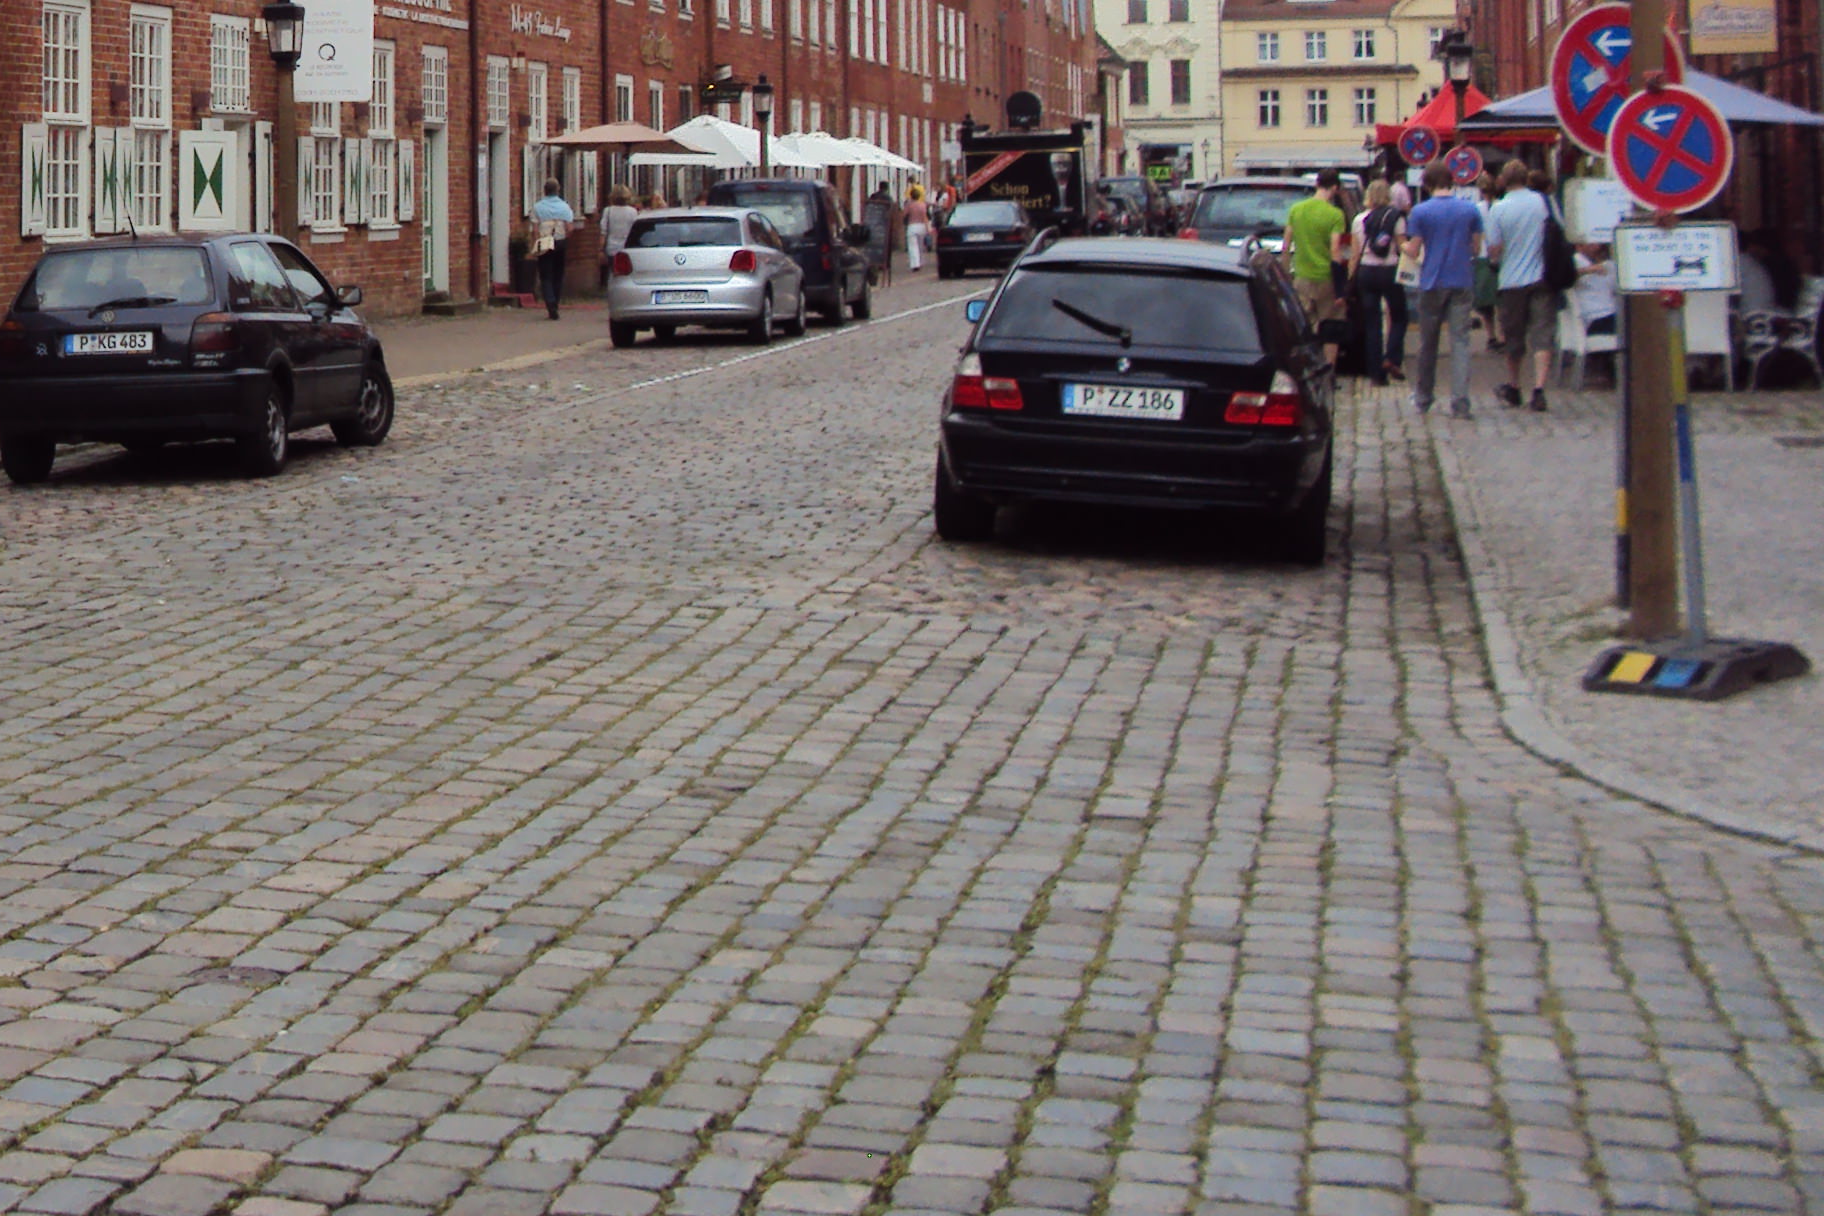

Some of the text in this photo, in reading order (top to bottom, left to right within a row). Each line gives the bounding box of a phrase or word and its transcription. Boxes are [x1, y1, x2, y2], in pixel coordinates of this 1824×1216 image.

[990, 183, 1030, 196] Schon
[80, 335, 147, 351] P KG 483
[1083, 387, 1175, 410] P ZZ 186
